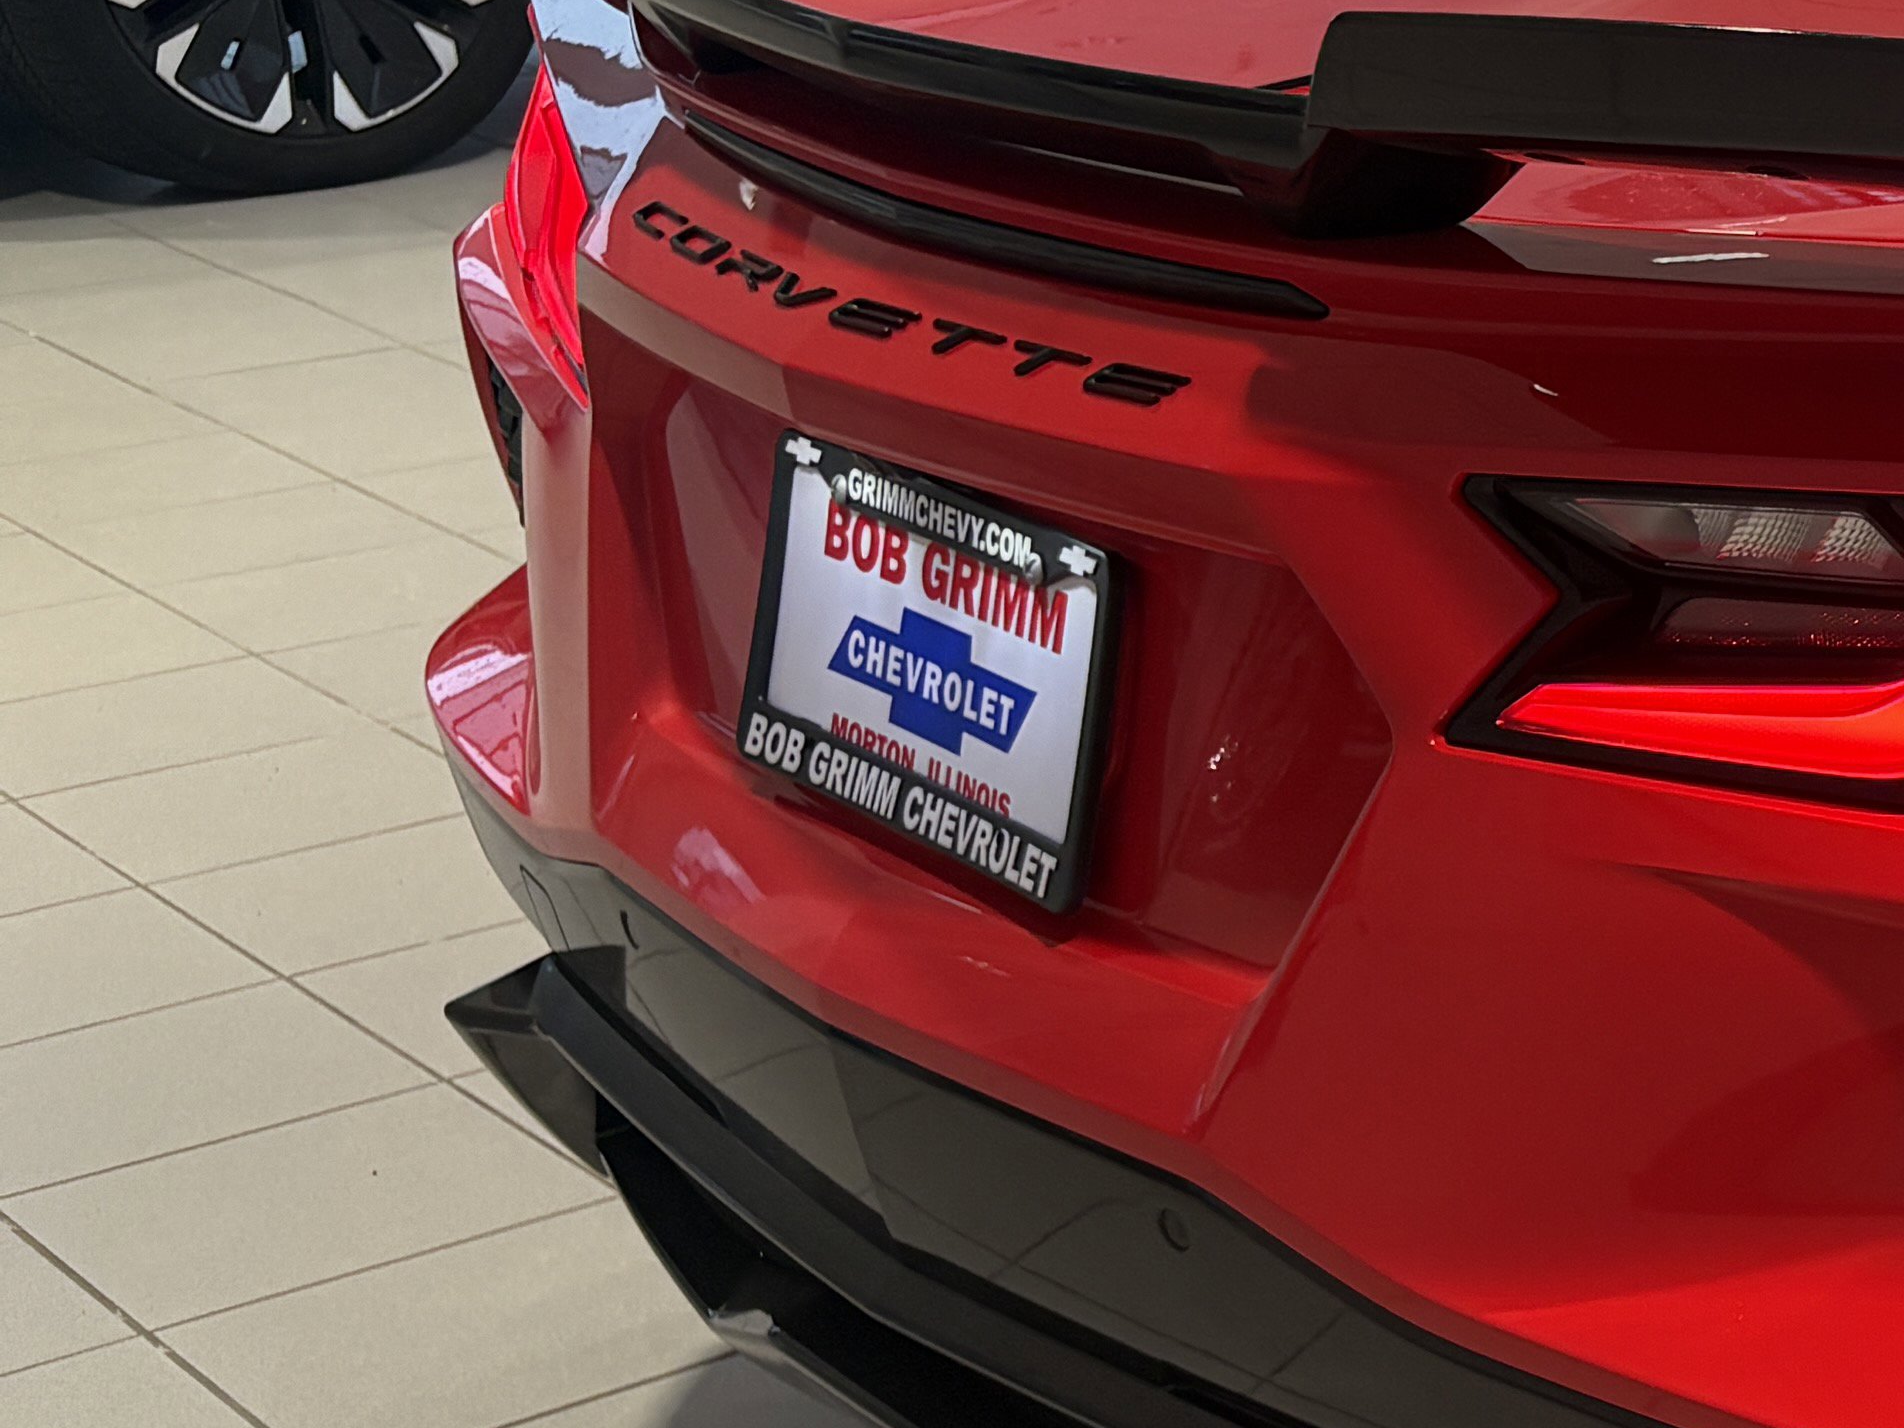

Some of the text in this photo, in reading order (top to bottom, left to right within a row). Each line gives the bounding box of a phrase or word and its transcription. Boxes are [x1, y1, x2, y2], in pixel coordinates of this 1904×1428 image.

[632, 200, 1193, 407] CORVETTE
[824, 497, 1069, 656] BOB GRIMM
[848, 467, 1032, 569] GRIMMCHEVY.COM
[847, 628, 1015, 736] CHEVROLET
[744, 712, 1057, 899] BOB GRIMM CHEVROLET
